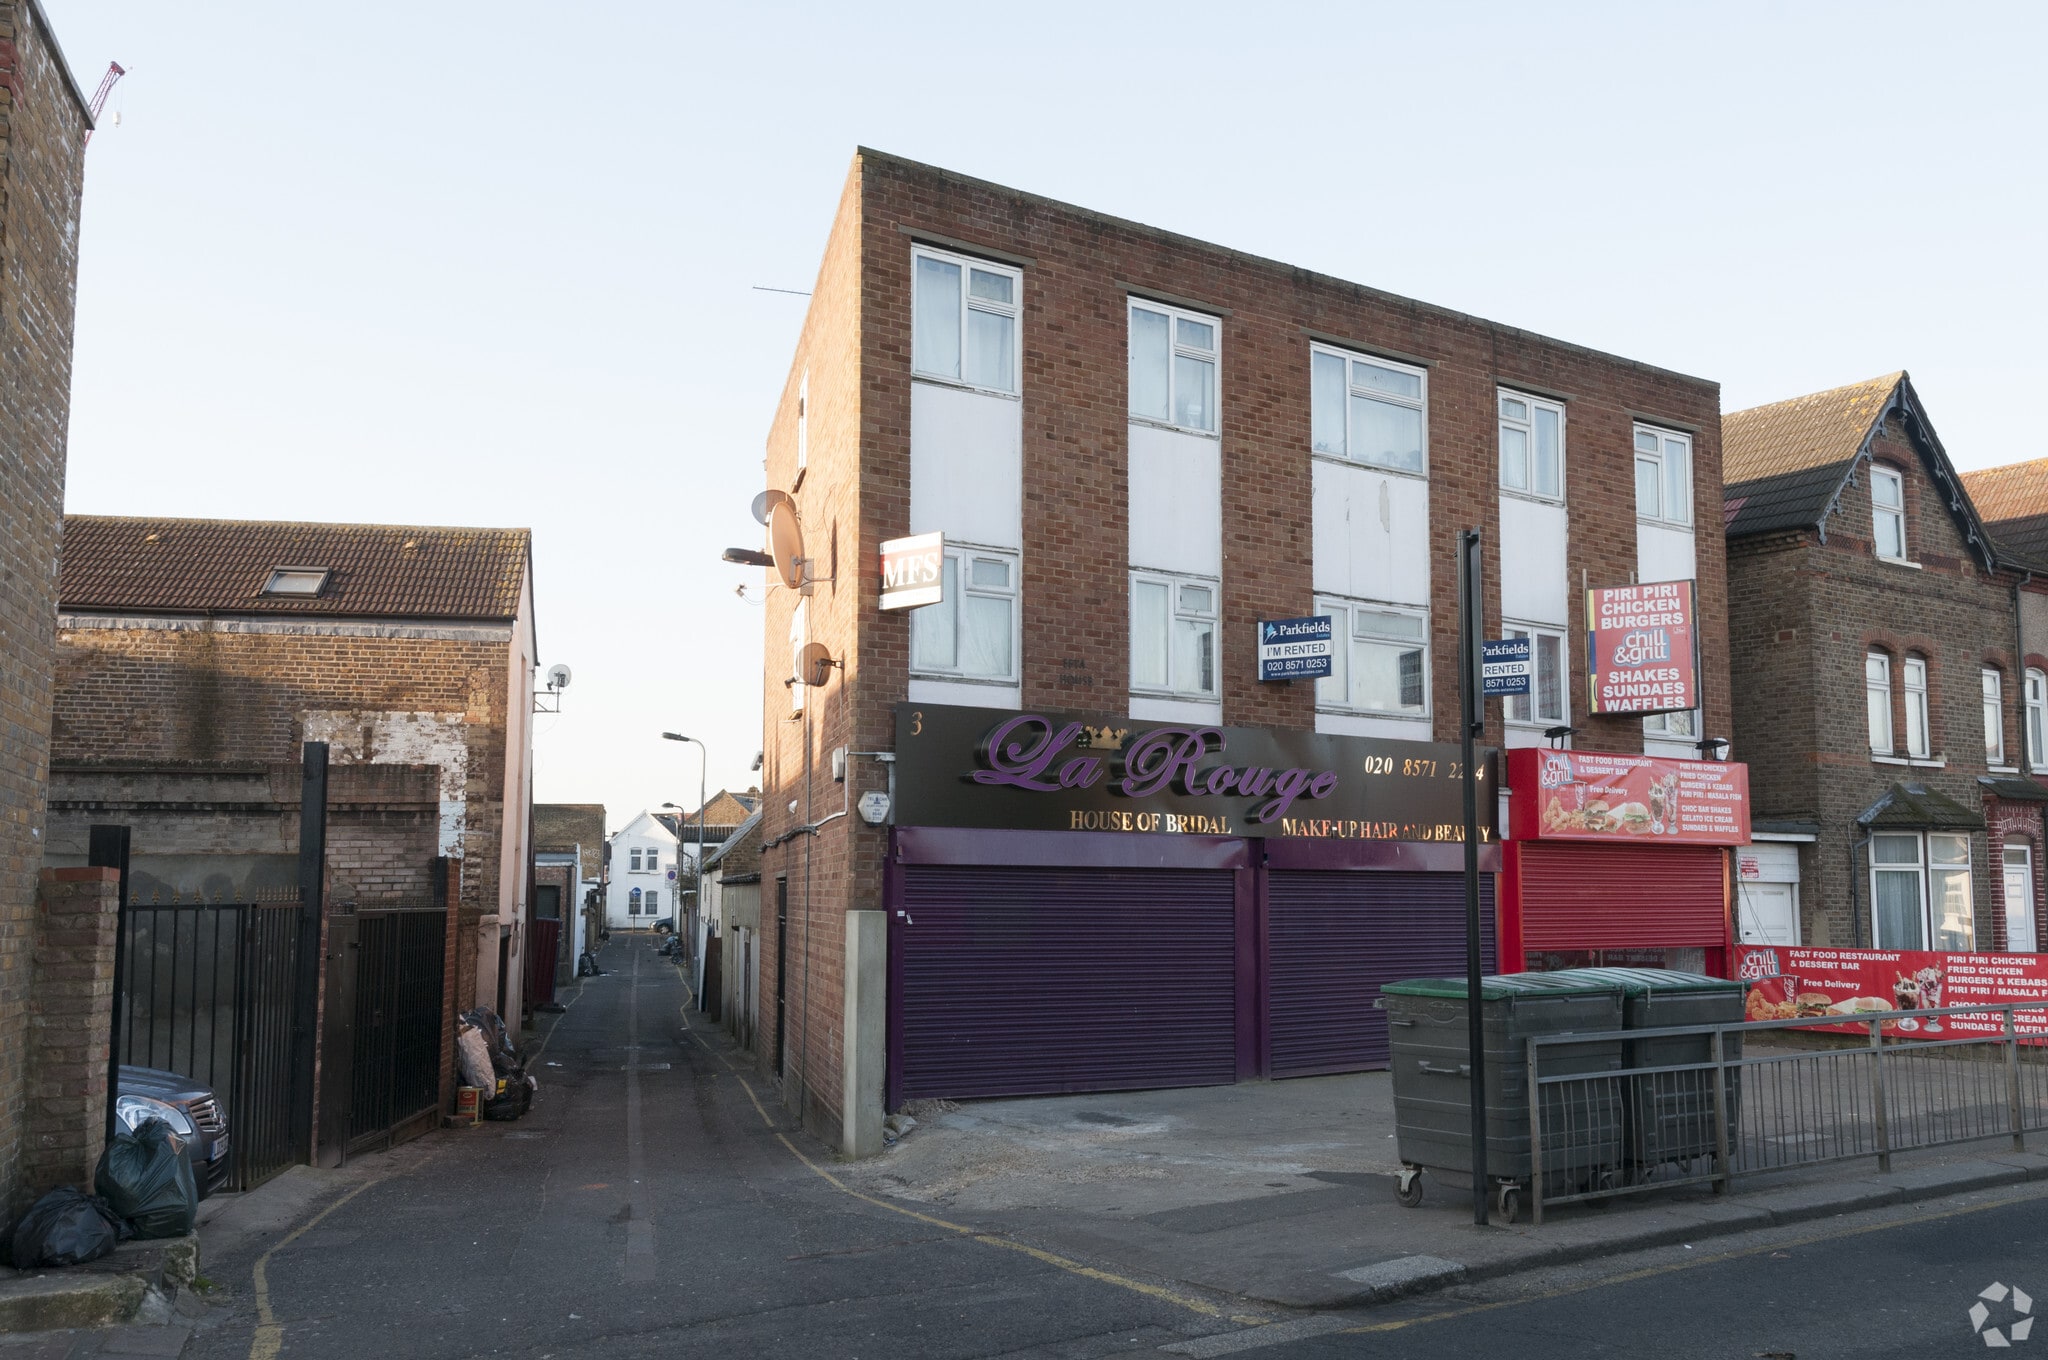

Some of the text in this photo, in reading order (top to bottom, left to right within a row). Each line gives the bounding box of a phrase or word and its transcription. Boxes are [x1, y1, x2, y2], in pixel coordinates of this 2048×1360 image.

[883, 552, 938, 589] MFS
[1603, 584, 1678, 602] PIRI PIRI
[1601, 598, 1681, 616] CHICKEN
[1601, 612, 1684, 630] BURGERS
[1280, 621, 1331, 636] Parkfields
[1625, 629, 1667, 649] chill
[1267, 643, 1326, 657] I'M RENTED
[1482, 643, 1529, 657] Parkfields
[1267, 658, 1327, 672] 020 8571 0253
[1484, 663, 1525, 675] RENTED
[1486, 677, 1526, 688] 8571 0253
[1608, 668, 1680, 684] SHAKES
[1603, 682, 1685, 699] SUNDAES
[1604, 696, 1686, 713] WAFFLES
[910, 711, 923, 736] 3
[1364, 755, 1485, 781] 020 8571 224
[1547, 754, 1570, 771] chill
[1596, 757, 1612, 765] FOOD
[1613, 758, 1653, 767] RESTAURANT
[973, 715, 1339, 824] La Rouge
[1697, 773, 1721, 781] CHICKEN
[1590, 785, 1628, 796] Free Delivery
[1698, 805, 1710, 813] BAR
[1710, 806, 1732, 814] SHAKES
[1070, 810, 1232, 834] HOUSE OF BRIDAL
[1682, 814, 1703, 822] GELATO
[1714, 815, 1733, 823] CREAM
[1282, 818, 1490, 843] MAKE-UP HAIR AND BEAY
[1682, 824, 1708, 832] SUNDAES
[1714, 825, 1739, 833] WAFFLES
[1746, 950, 1777, 966] chill
[1789, 950, 1901, 961] FAST FOOD RESTAURANT
[1946, 956, 2037, 966] PIRI PIRI CHICKEN
[1790, 960, 1860, 970] & DESSERT BAR
[1947, 965, 2024, 976] FRIED CHICKEN
[1803, 979, 1861, 990] Free Delivery
[1947, 975, 1994, 985] BURGERS
[2007, 977, 2048, 987] KEBABS
[1948, 985, 1968, 994] PIRI
[1970, 986, 1991, 995] PIRI
[1997, 988, 2040, 997] MASALA
[1950, 1021, 1997, 1031] SUNDAES
